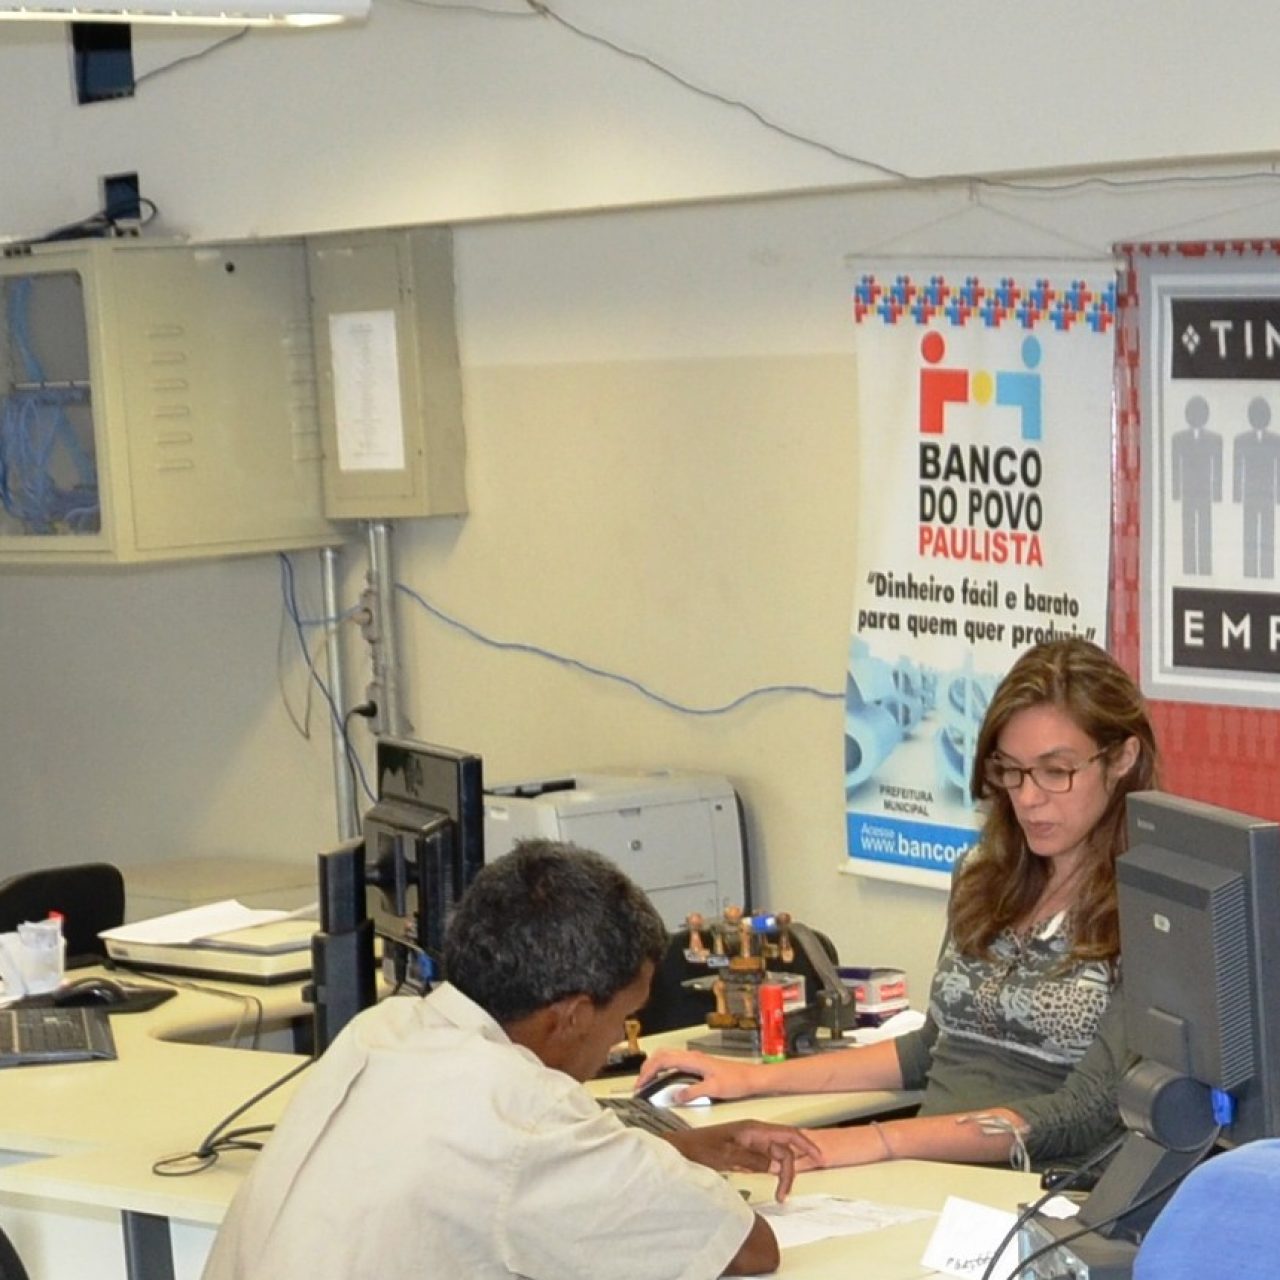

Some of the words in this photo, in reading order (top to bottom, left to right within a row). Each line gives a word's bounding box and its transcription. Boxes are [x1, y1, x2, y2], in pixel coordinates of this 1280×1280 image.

[919, 441, 1042, 488] BANCO
[919, 484, 957, 525] DO
[968, 487, 1043, 532] POVO
[918, 524, 1043, 567] PAULISTA
[962, 577, 999, 608] fácil
[1005, 590, 1017, 610] e
[1024, 583, 1080, 617] barato
[857, 608, 901, 633] para
[906, 614, 958, 638] quem
[963, 619, 1005, 644] quer
[879, 783, 934, 803] PREFEITURA
[883, 799, 930, 817] MUNICIPAL
